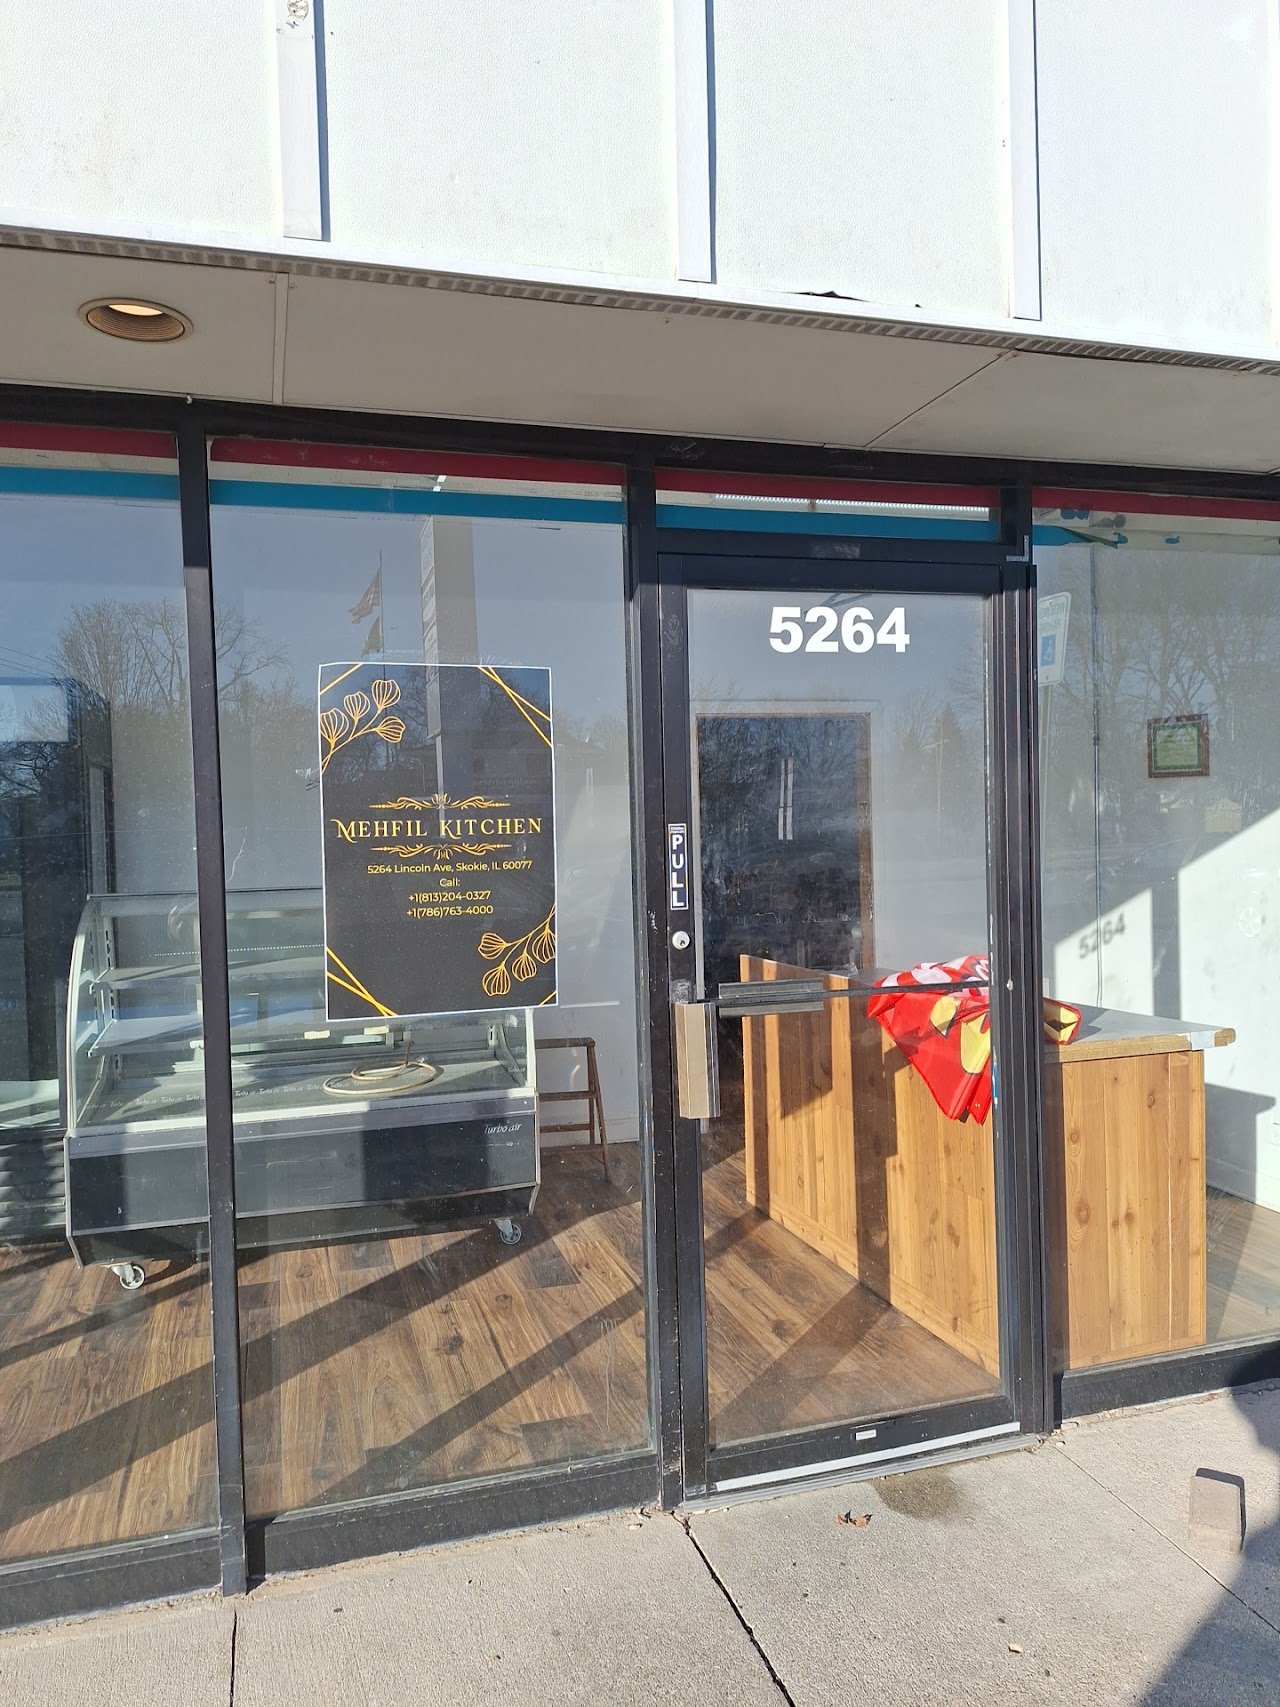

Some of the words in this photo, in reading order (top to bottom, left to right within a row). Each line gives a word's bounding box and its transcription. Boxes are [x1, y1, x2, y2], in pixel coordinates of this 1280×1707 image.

[769, 606, 910, 653] 5264
[330, 819, 428, 843] MEHFIL
[440, 818, 542, 839] KITCHEN
[367, 864, 392, 874] 5264
[394, 863, 431, 873] Lincoln
[433, 863, 454, 873] Ave,
[456, 861, 490, 871] Skokie,
[492, 861, 501, 870] IL
[502, 860, 533, 870] 60077
[671, 834, 685, 907] PULL
[439, 877, 461, 887] Call:
[408, 890, 492, 904] +1(813)204-0327
[406, 905, 494, 919] +1(786)763-4000
